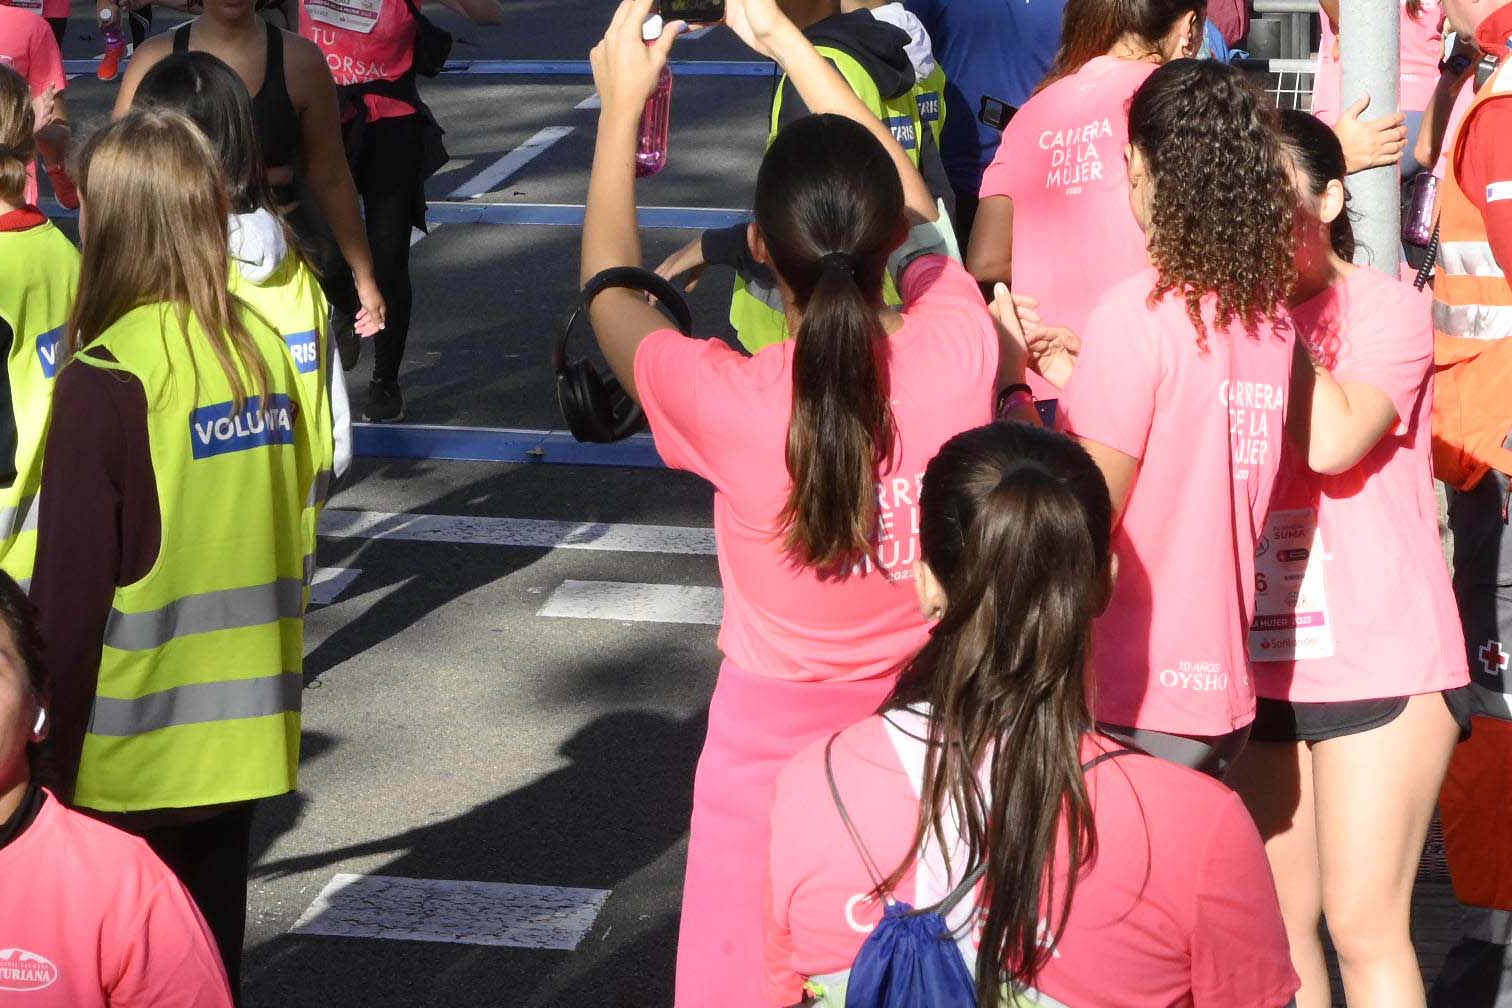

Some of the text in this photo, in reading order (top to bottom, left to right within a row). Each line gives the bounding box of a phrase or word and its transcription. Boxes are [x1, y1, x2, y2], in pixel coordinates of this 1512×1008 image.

[312, 26, 336, 46] TU
[1076, 142, 1099, 162] LA
[1046, 160, 1104, 188] MUJER
[1249, 411, 1268, 438] LA
[1159, 668, 1228, 691] OYSHO
